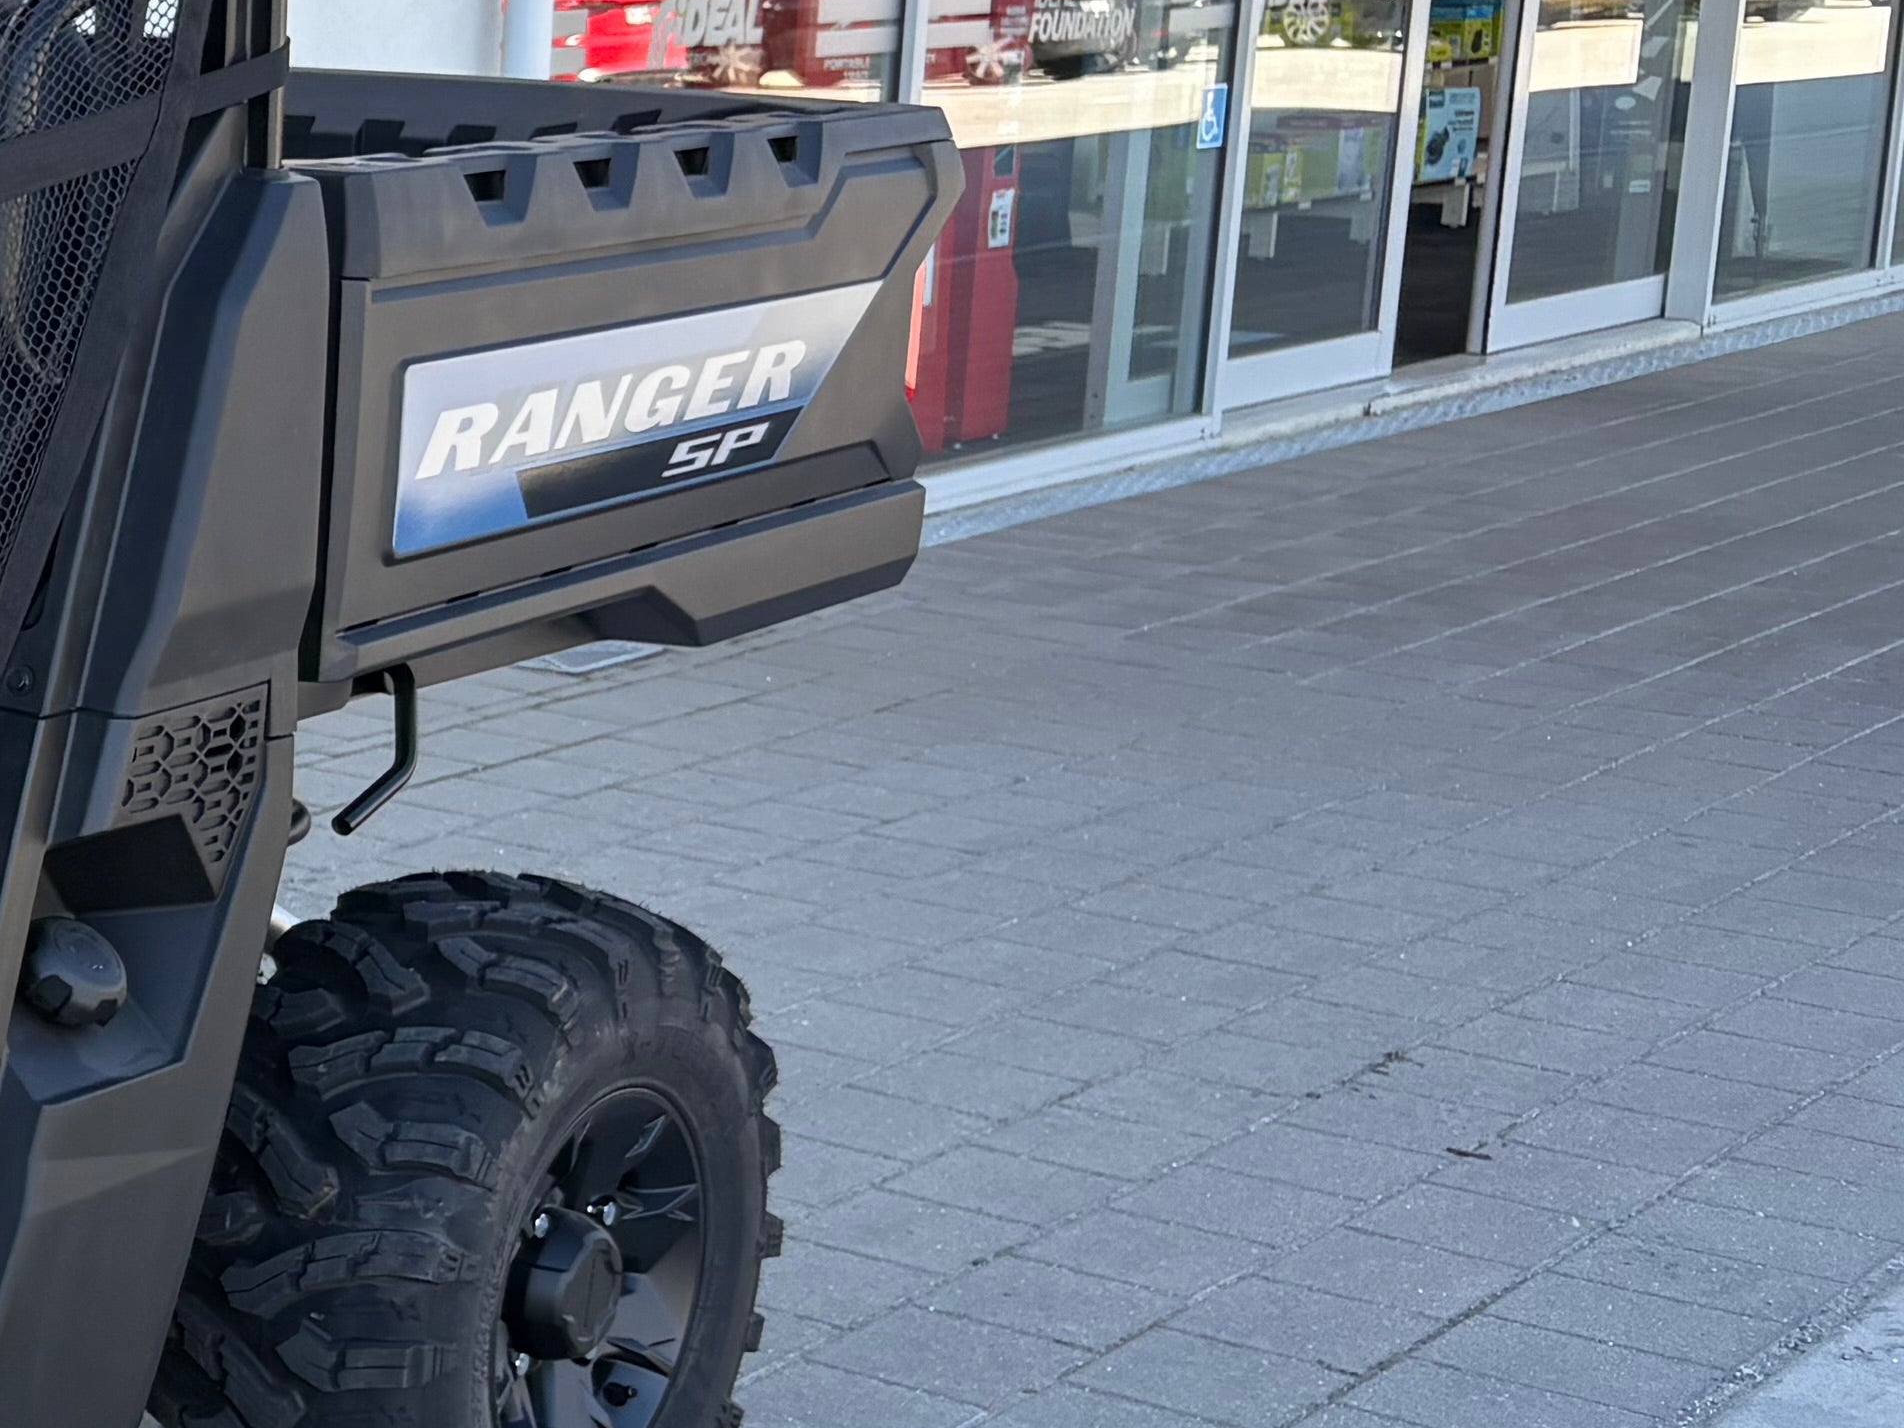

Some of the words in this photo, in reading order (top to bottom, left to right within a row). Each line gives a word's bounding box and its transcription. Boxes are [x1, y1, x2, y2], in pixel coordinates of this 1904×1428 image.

[1027, 3, 1136, 44] FOUNDATION
[414, 339, 807, 480] RANGER
[661, 421, 771, 478] SP
